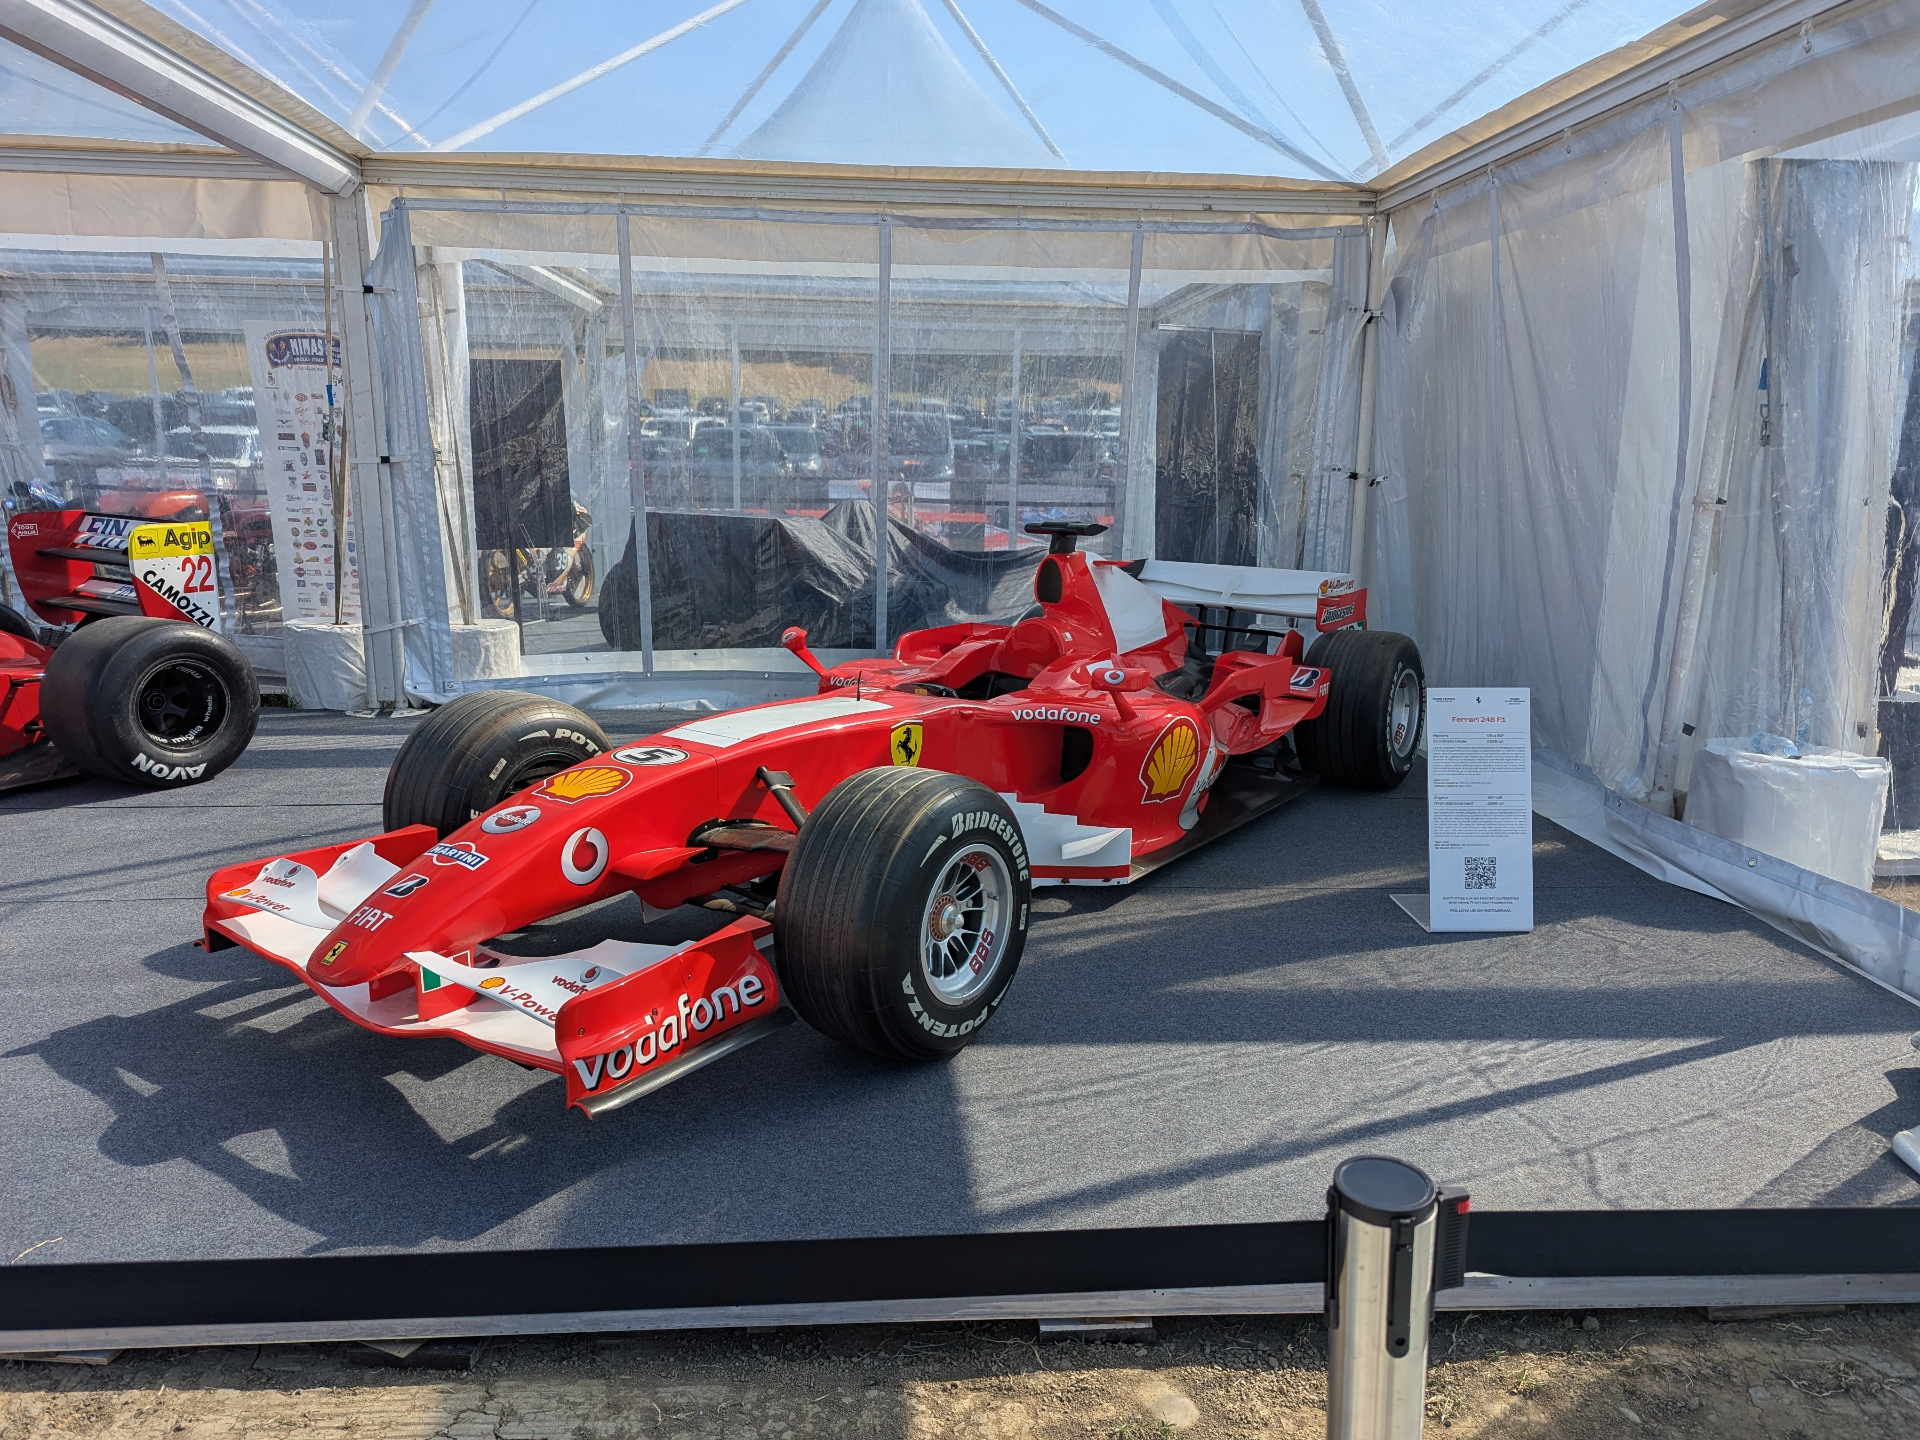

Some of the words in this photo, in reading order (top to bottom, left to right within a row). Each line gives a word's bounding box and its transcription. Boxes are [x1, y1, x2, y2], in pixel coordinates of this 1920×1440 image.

[164, 527, 211, 551] Agip
[181, 555, 215, 594] 22
[555, 552, 568, 571] 39
[143, 570, 215, 629] CAMOZZI
[1319, 681, 1331, 698] FIAT
[203, 695, 213, 722] wheels
[1010, 707, 1101, 725] vodafone
[171, 725, 204, 744] miglia
[131, 752, 208, 780] AVON
[619, 748, 679, 763] 5
[492, 812, 532, 826] vodafone
[429, 844, 482, 868] MARTINI
[951, 810, 1030, 882] BRIDGESTONE
[347, 905, 394, 932] FIAT
[968, 927, 995, 975] BBS
[901, 971, 988, 1038] POTENZA
[572, 974, 765, 1091] vodafone
